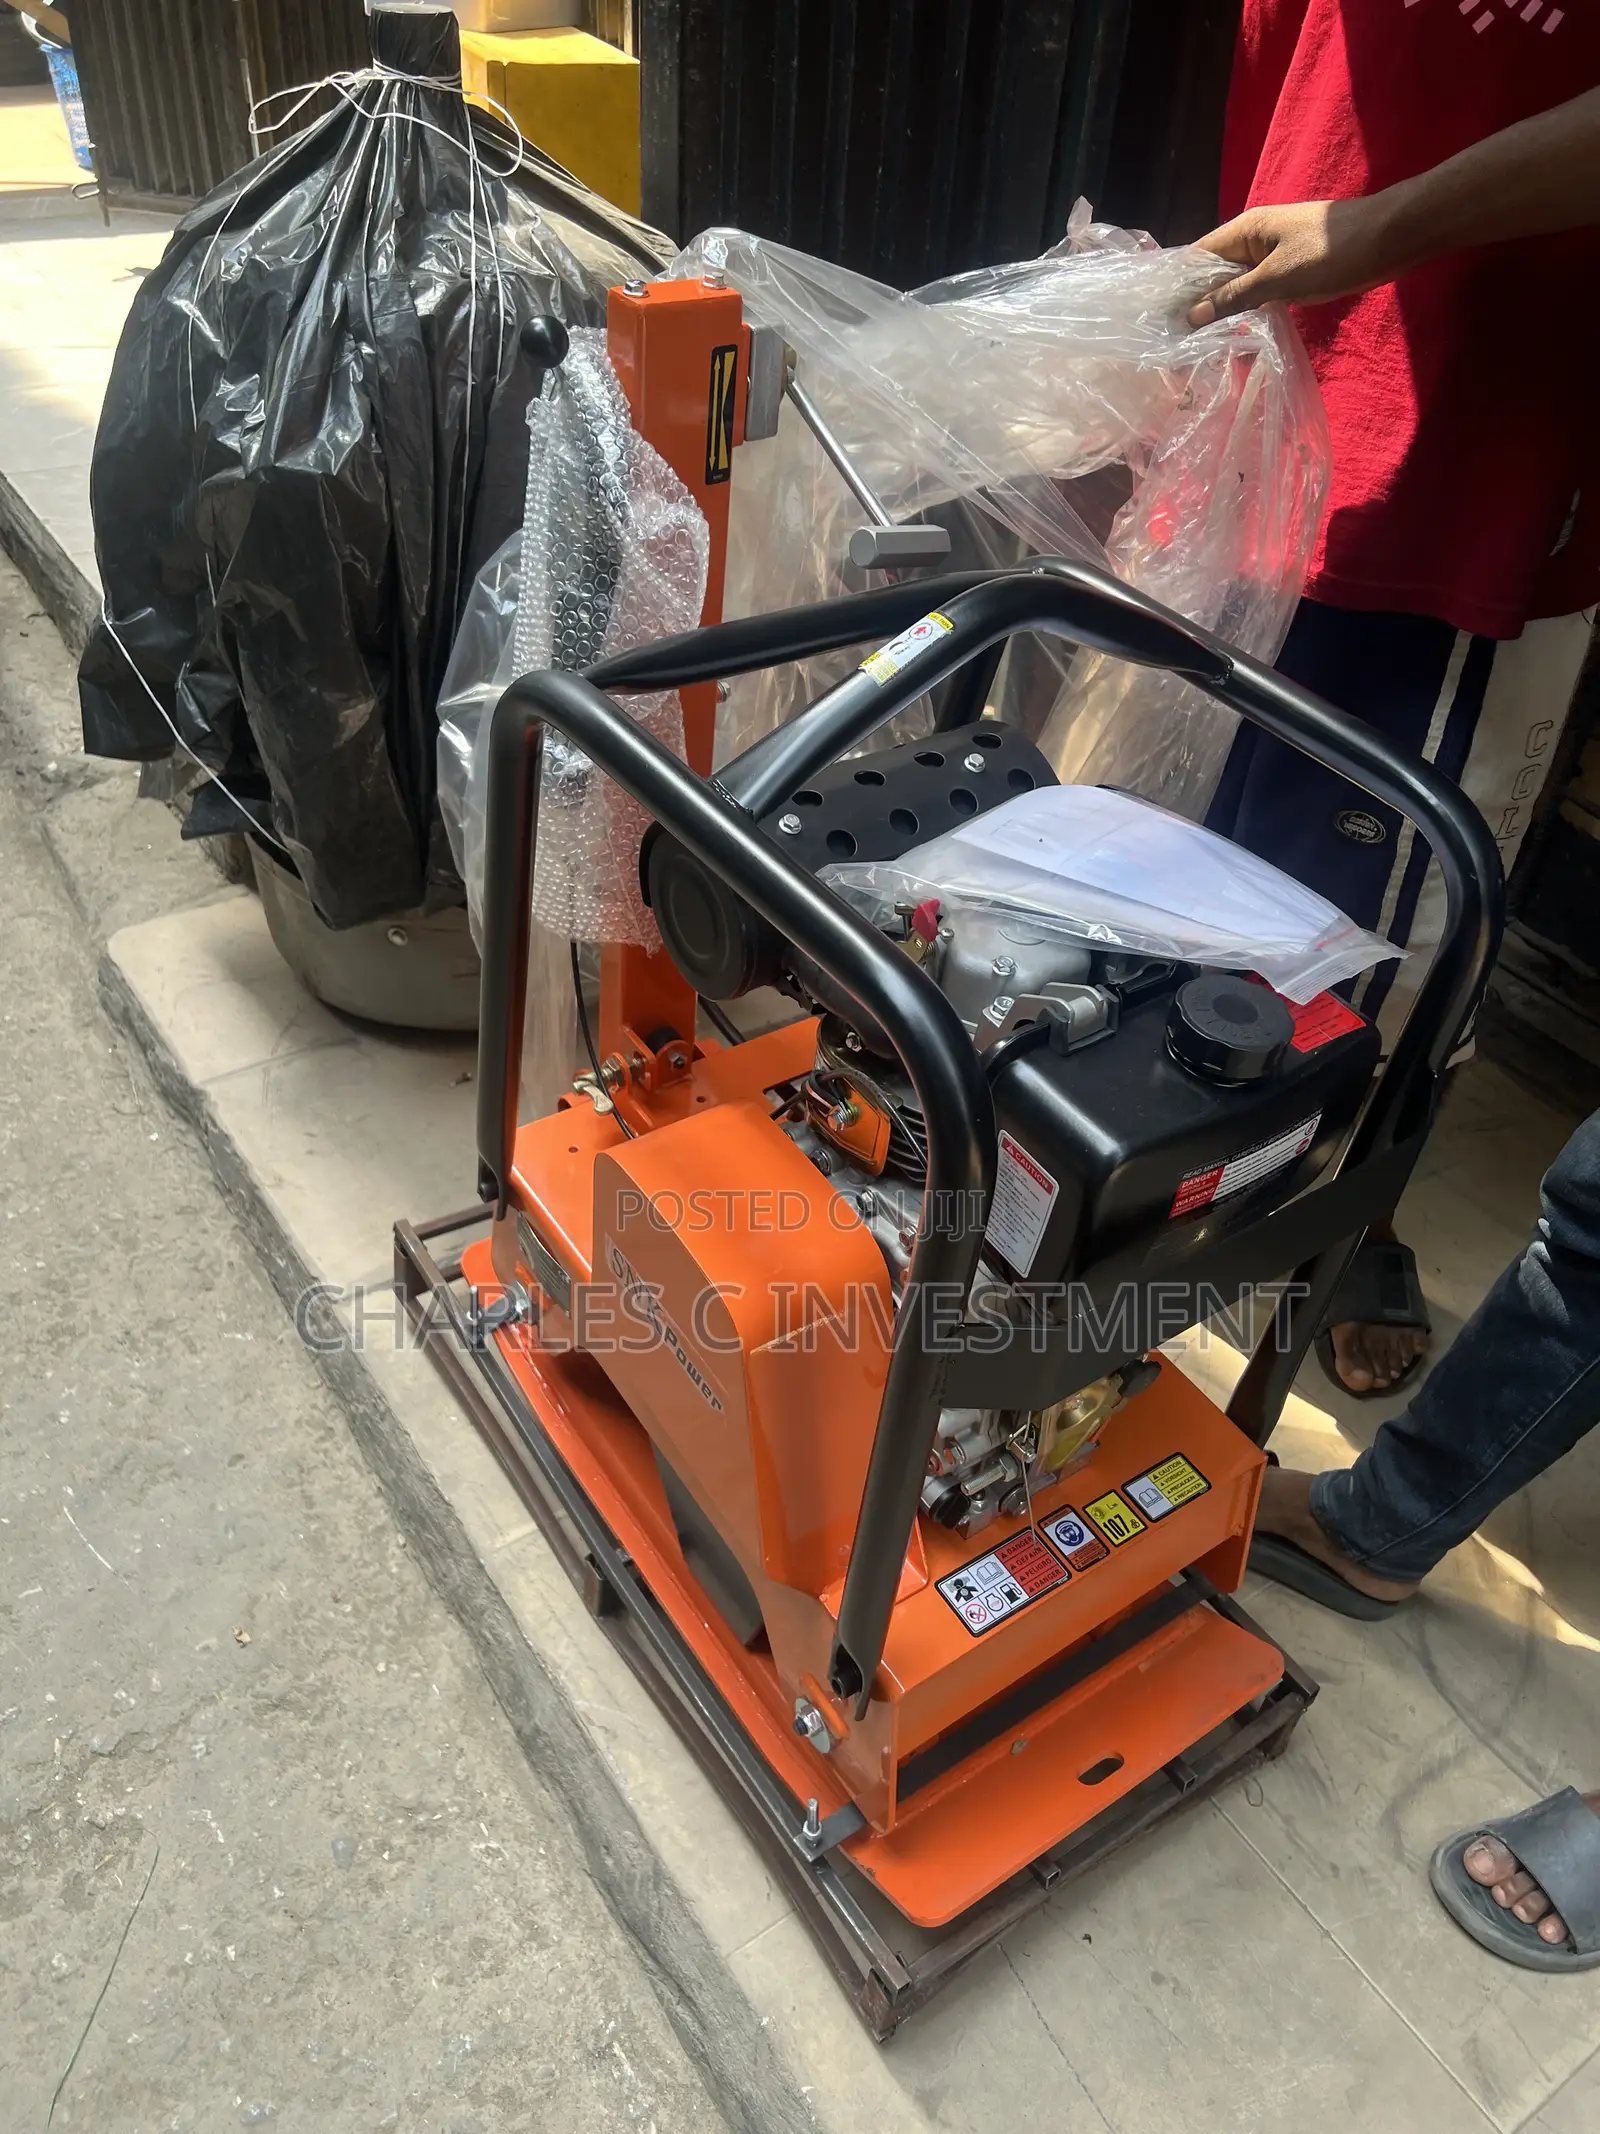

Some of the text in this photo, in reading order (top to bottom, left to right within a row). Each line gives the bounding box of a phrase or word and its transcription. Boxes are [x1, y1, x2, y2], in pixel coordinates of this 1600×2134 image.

[1014, 1152, 1049, 1190] CAUTION
[1181, 1169, 1220, 1189] DANGER
[1175, 1188, 1216, 1208] WARNING
[1158, 1460, 1183, 1476] CAUTION
[1102, 1513, 1130, 1541] 107
[1006, 1536, 1034, 1555] DANGER
[1016, 1547, 1043, 1566] GEFAHR
[1025, 1558, 1053, 1577] PELIGRO
[1034, 1568, 1061, 1588] DANGER
